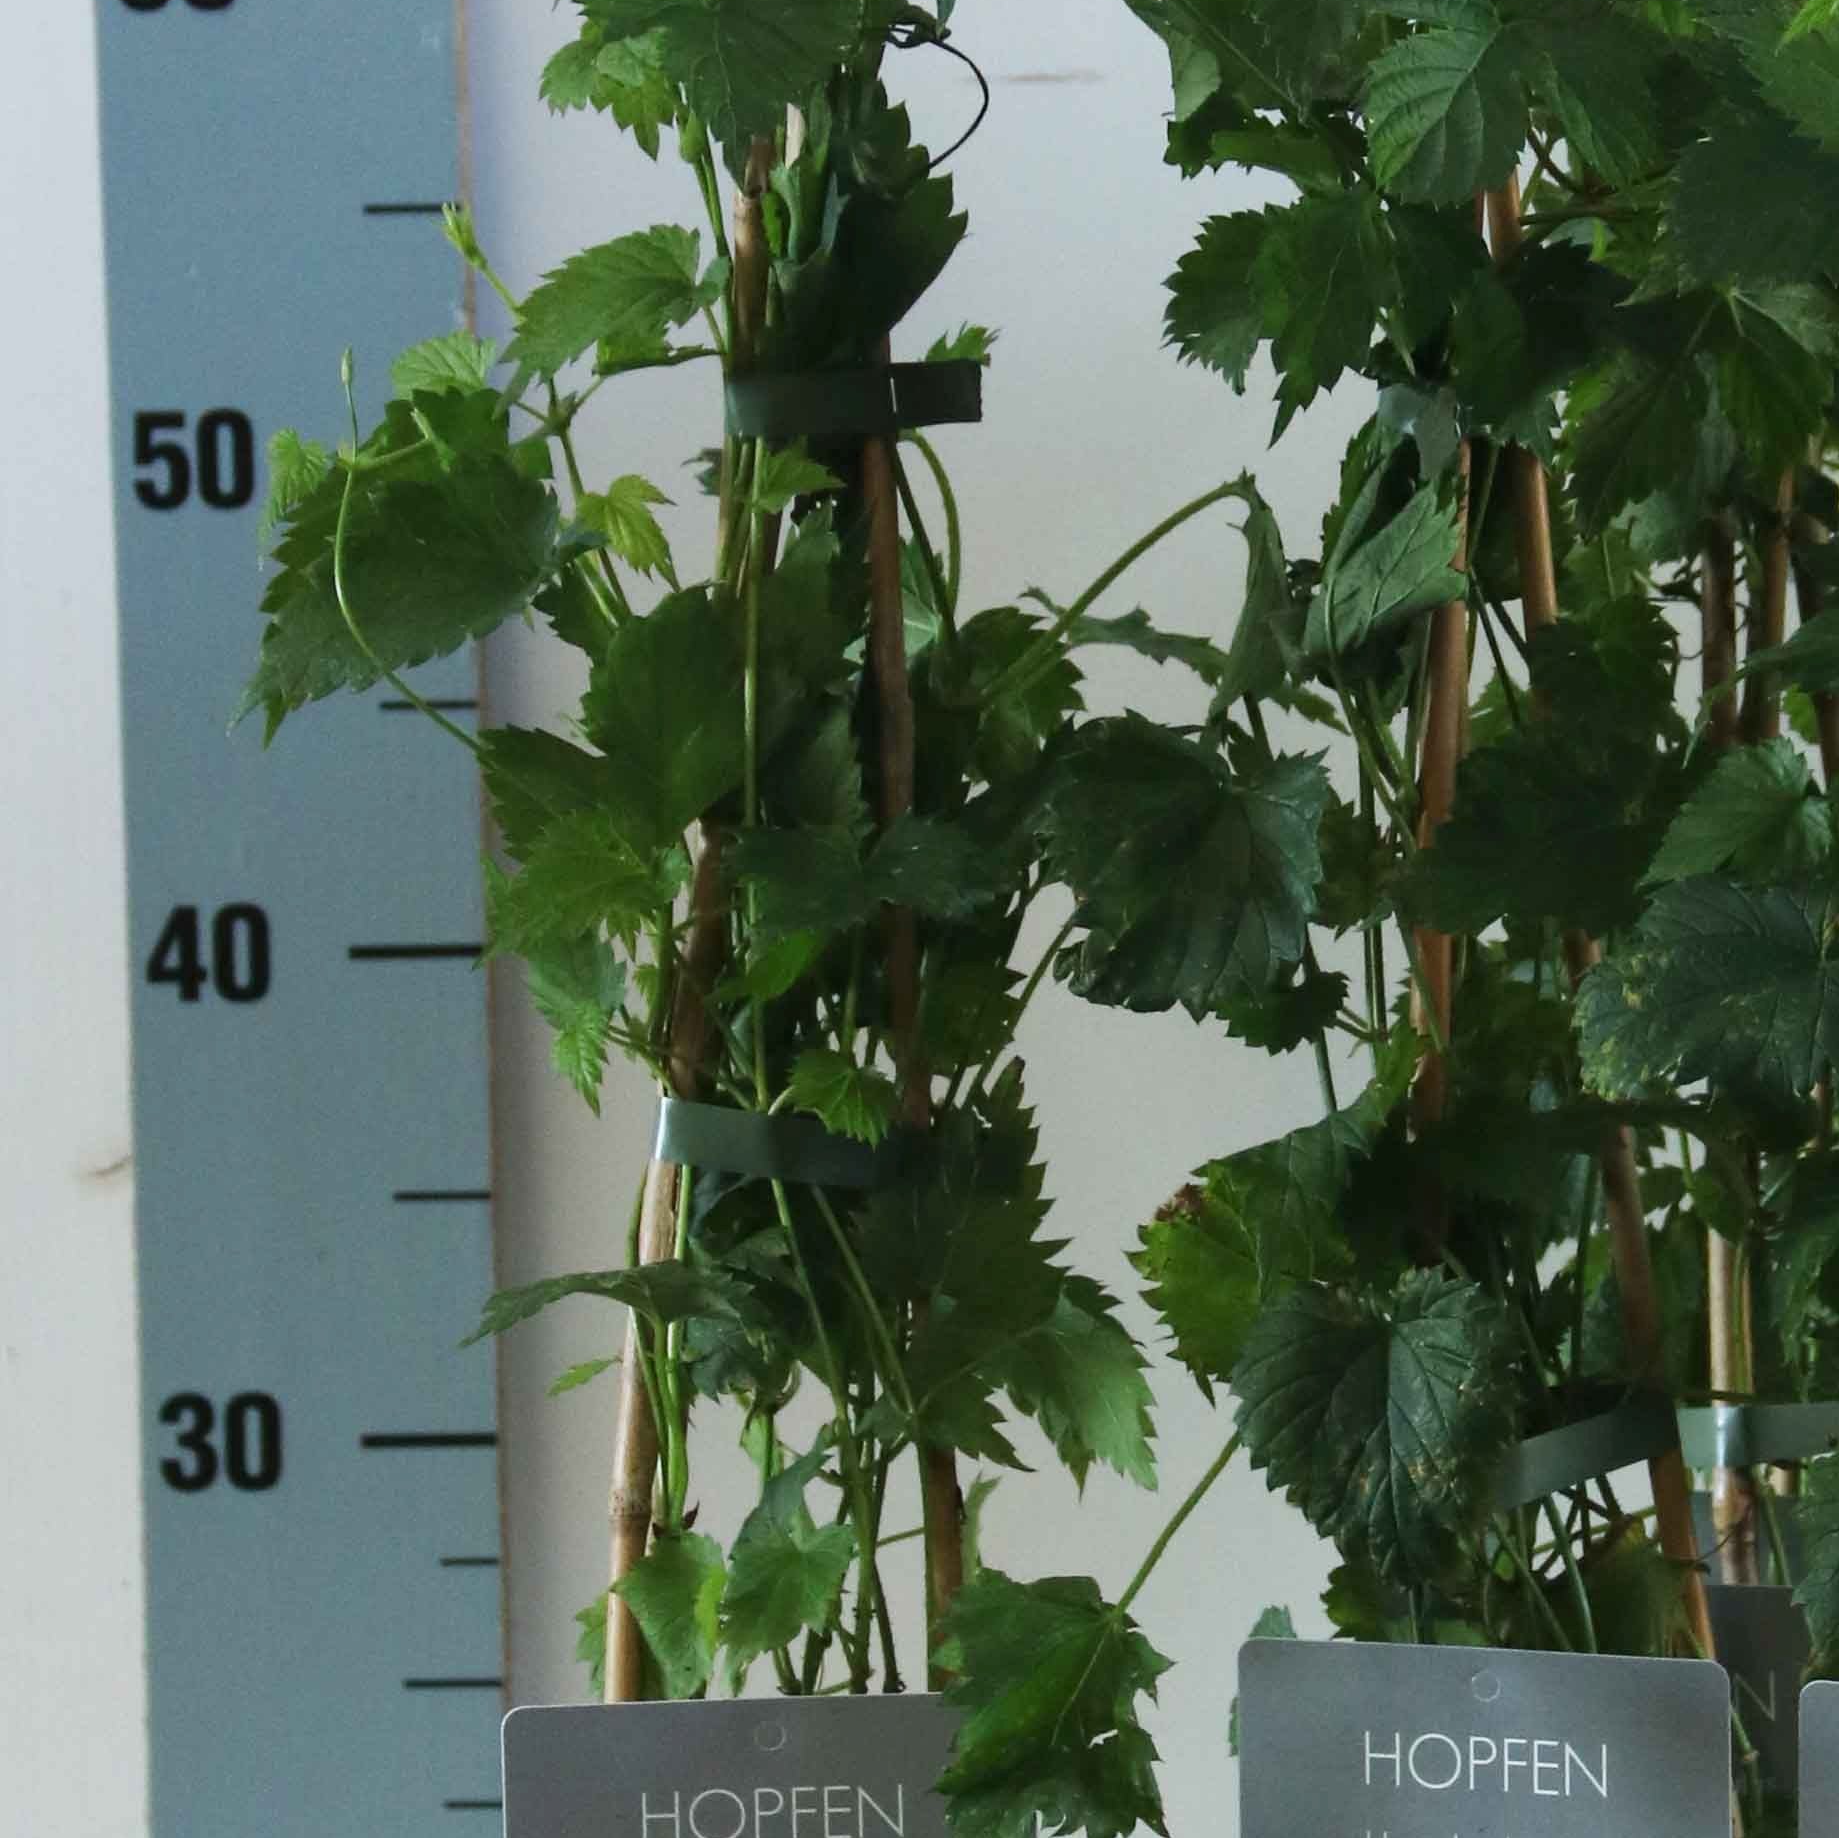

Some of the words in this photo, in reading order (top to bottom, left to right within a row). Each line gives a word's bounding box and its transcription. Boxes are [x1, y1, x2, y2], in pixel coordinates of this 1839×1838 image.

[132, 407, 257, 513] 50
[144, 900, 273, 1006] 40
[157, 1389, 285, 1494] 30
[1364, 1730, 1609, 1800] HOPFEN
